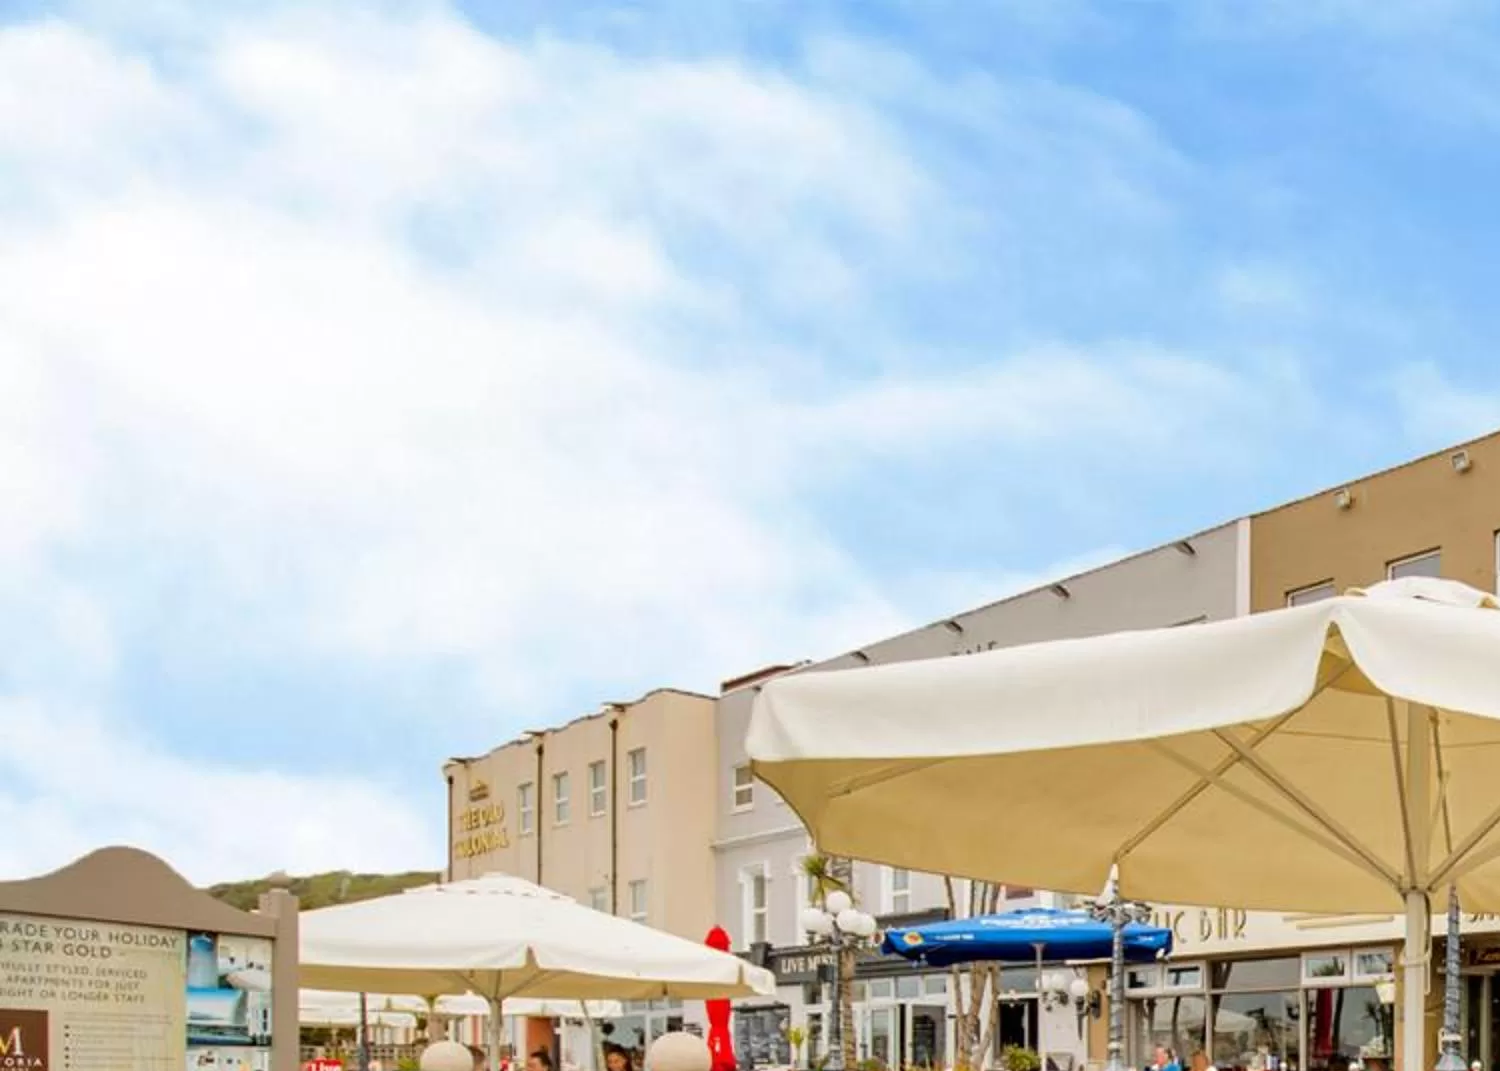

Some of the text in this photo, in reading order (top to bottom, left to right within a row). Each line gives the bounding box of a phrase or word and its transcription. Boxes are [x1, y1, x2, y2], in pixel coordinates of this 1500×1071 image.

[1199, 905, 1247, 942] BAR
[54, 926, 99, 942] YOUR
[109, 931, 178, 948] HOLIDAY
[11, 939, 55, 954] STAR
[63, 943, 112, 959] GOLD
